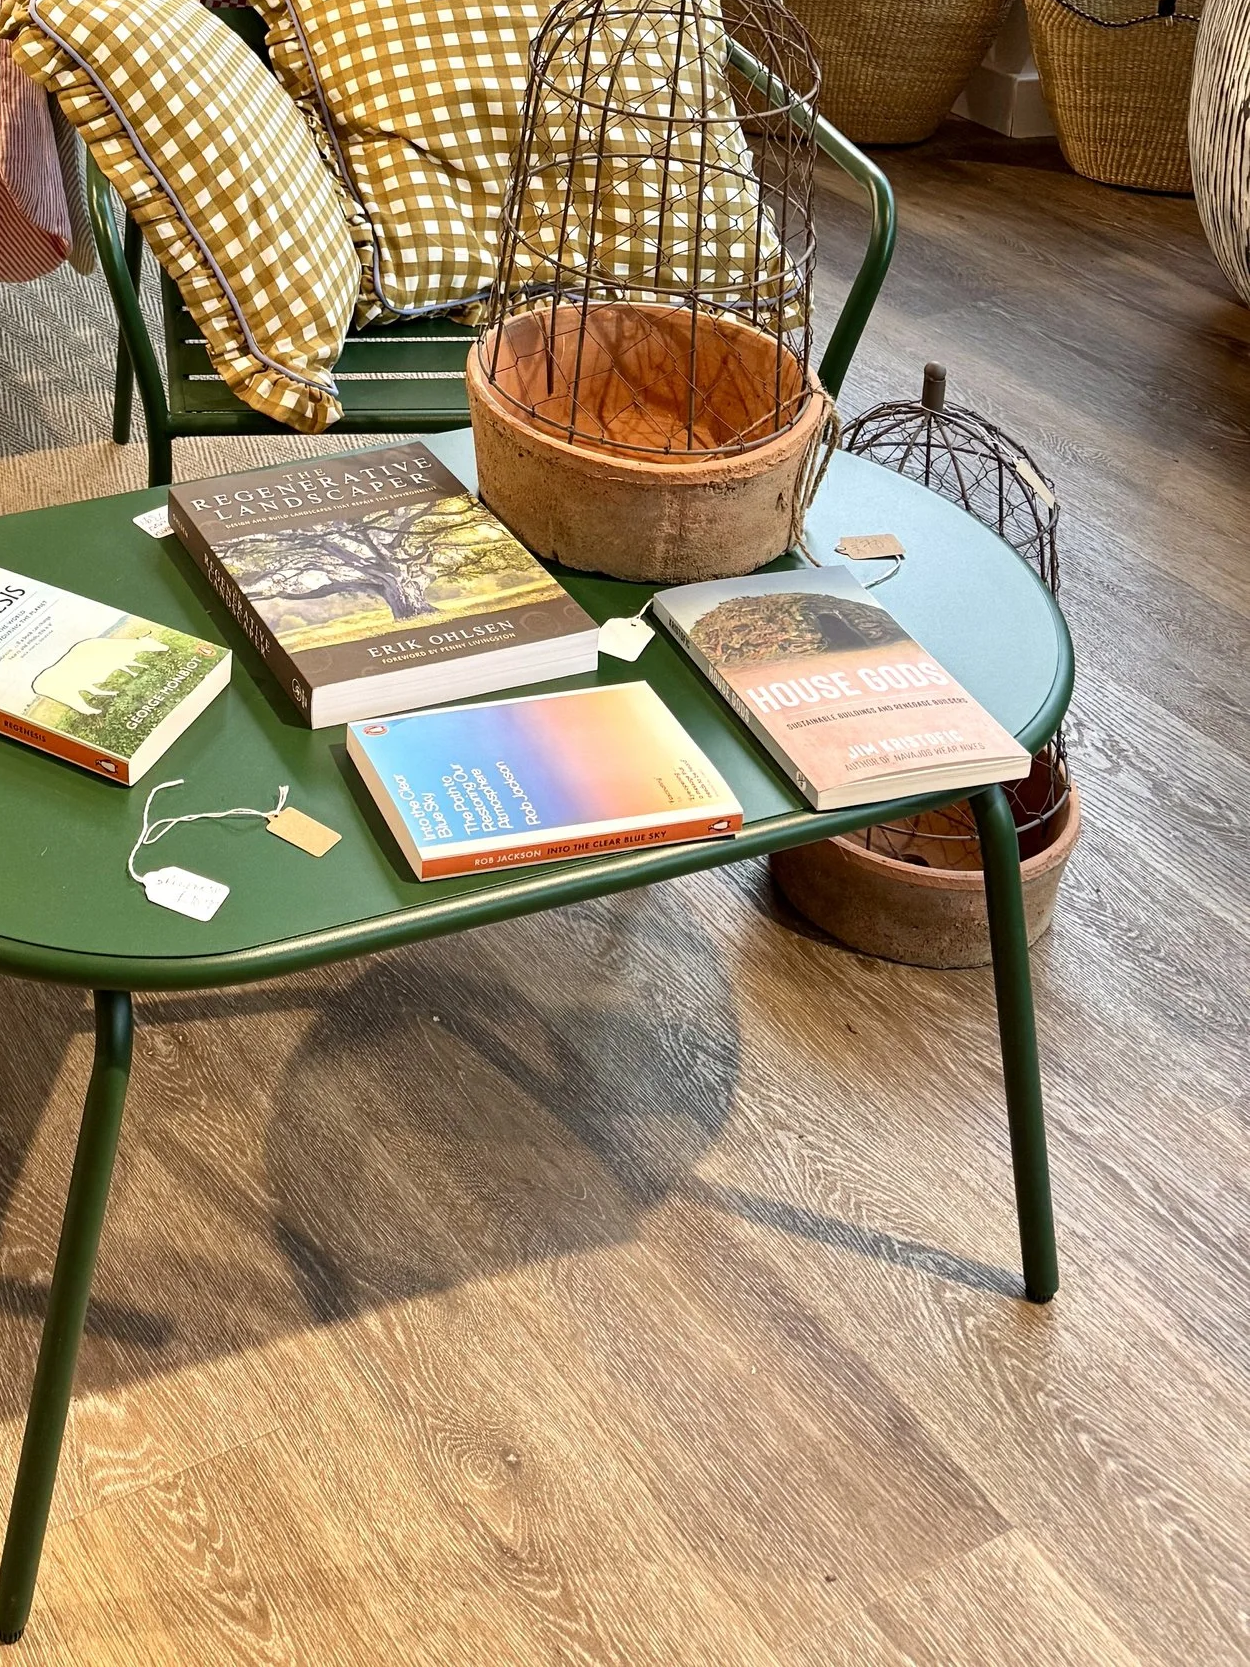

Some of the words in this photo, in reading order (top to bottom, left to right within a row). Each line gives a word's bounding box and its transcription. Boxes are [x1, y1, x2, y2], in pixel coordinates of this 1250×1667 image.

[190, 456, 433, 513] REGENERATIVE
[282, 467, 328, 483] THE
[214, 472, 431, 522] LANDSCAPER
[225, 518, 250, 530] DESIGN
[252, 517, 267, 525] AND
[268, 513, 288, 522] BUILD
[290, 506, 332, 519] LANDSCAPES
[333, 502, 350, 512] THAT
[351, 499, 374, 508] REPAIR
[375, 496, 389, 504] THE
[390, 485, 438, 501] ENVIRONMENT
[204, 553, 271, 654] REGENERATIVE
[208, 569, 267, 659] LANDSCAPER
[367, 638, 423, 658] ERIK
[429, 620, 515, 645] OHLSEN
[382, 651, 427, 664] FOREWORD
[440, 642, 466, 653] PENNY
[469, 632, 516, 647] LIVINGSTON
[125, 693, 165, 731] GEORGE
[161, 656, 202, 697] MONBIOT
[708, 663, 731, 700] HOUSE
[731, 695, 750, 723] GODS
[746, 671, 863, 714] HOUSE
[857, 661, 950, 694] GODS
[786, 713, 837, 731] SUSTAINABLE
[837, 706, 877, 721] BUILDINGS
[878, 703, 894, 714] AND
[894, 698, 932, 712] RENEGADE
[932, 696, 968, 707] BUILDERS
[3, 719, 47, 743] REGENESIS
[847, 743, 879, 760] JIM
[878, 729, 964, 753] KRISTOFIC
[845, 757, 881, 772] AUTHOR
[881, 754, 893, 765] OF
[894, 748, 932, 762] NAVAJOS
[934, 744, 959, 756] WEAR
[960, 741, 986, 752] NIKES
[393, 774, 415, 801] Clear
[441, 775, 454, 790] to
[450, 763, 468, 783] Our
[495, 761, 528, 802] Jackson
[410, 800, 426, 818] the
[421, 792, 440, 812] Sky
[449, 790, 469, 813] Path
[464, 782, 497, 833] Restoring
[470, 768, 514, 829] Atmosphere
[519, 803, 541, 826] Rob
[419, 820, 437, 841] Into
[433, 812, 453, 839] Blue
[462, 811, 480, 836] The
[474, 855, 494, 866] ROB
[497, 849, 541, 863] JACKSON
[547, 845, 570, 855] INTO
[573, 842, 590, 851] THE
[592, 836, 621, 849] CLEAR
[624, 832, 645, 843] BLUE
[648, 830, 667, 840] SKY
